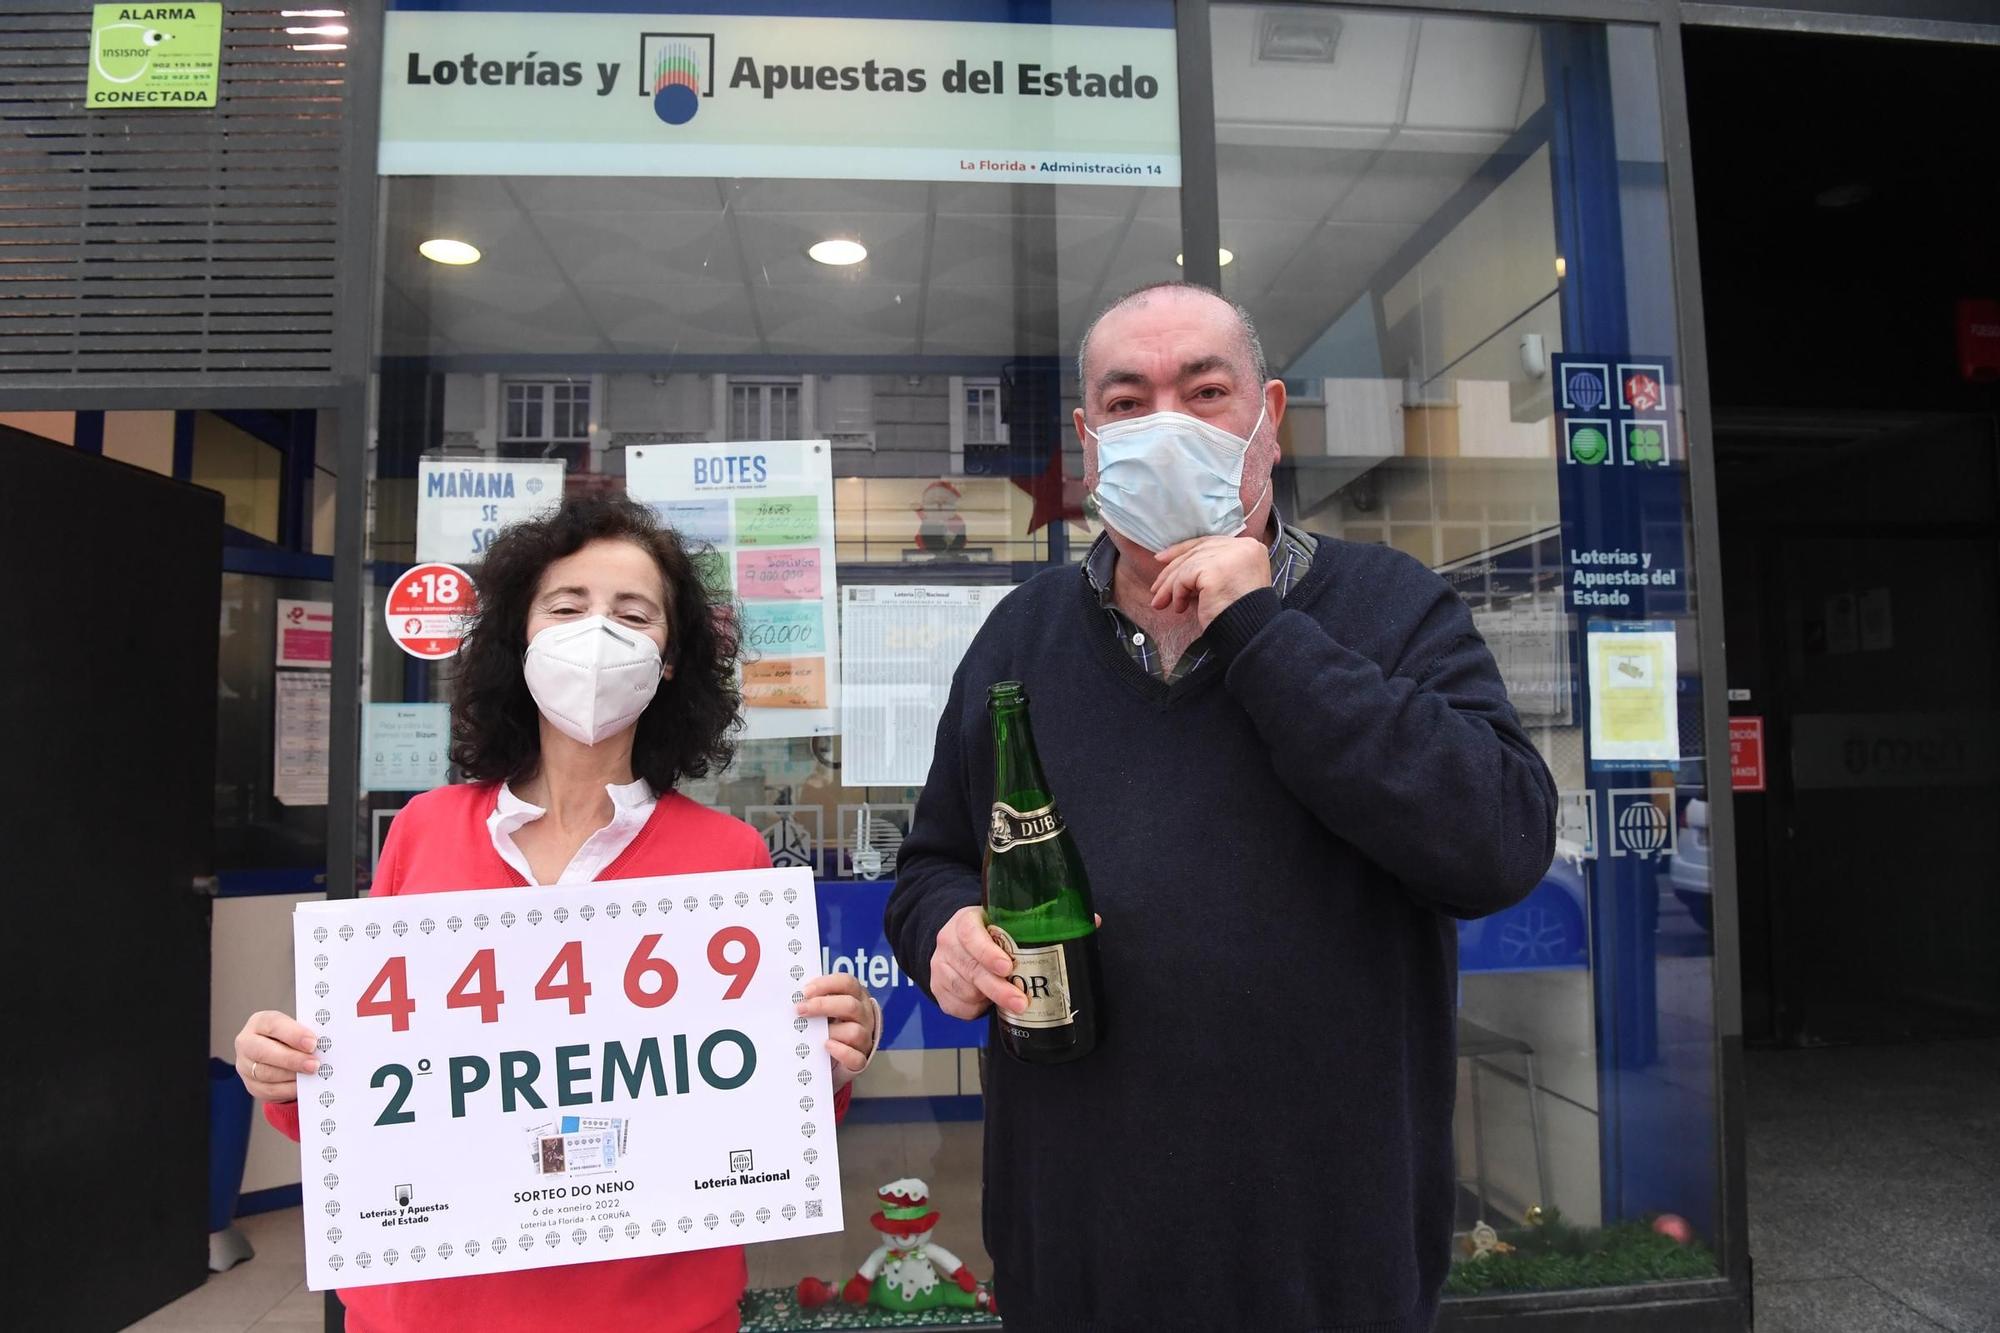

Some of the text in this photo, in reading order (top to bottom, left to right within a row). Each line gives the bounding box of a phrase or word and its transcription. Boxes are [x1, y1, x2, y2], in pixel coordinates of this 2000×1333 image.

[119, 9, 196, 20] ALARMA
[407, 51, 1158, 99] Loterías y Apuestas del Estado
[94, 91, 208, 102] CONECTADA
[960, 160, 1162, 175] La Florida Administración 14
[694, 455, 767, 485] BOTES
[427, 468, 515, 499] MAÑANA
[482, 505, 498, 522] SE
[1571, 549, 1652, 568] Loterías y
[1573, 568, 1676, 589] Apuestas del
[406, 574, 459, 604] +18
[1573, 589, 1630, 606] Estado
[449, 1028, 757, 1118] PREMIO
[739, 1169, 790, 1185] Nacional
[513, 1180, 635, 1204] SORTEO DO NENO
[399, 1208, 405, 1217] y
[407, 1203, 449, 1215] Apuestas
[532, 1199, 620, 1217] 6 de xaneiro 2022
[381, 1215, 429, 1227] del Estado
[548, 1218, 557, 1227] La
[558, 1215, 584, 1225] Florida
[590, 1214, 597, 1222] A
[597, 1210, 631, 1221] CORUÑA
